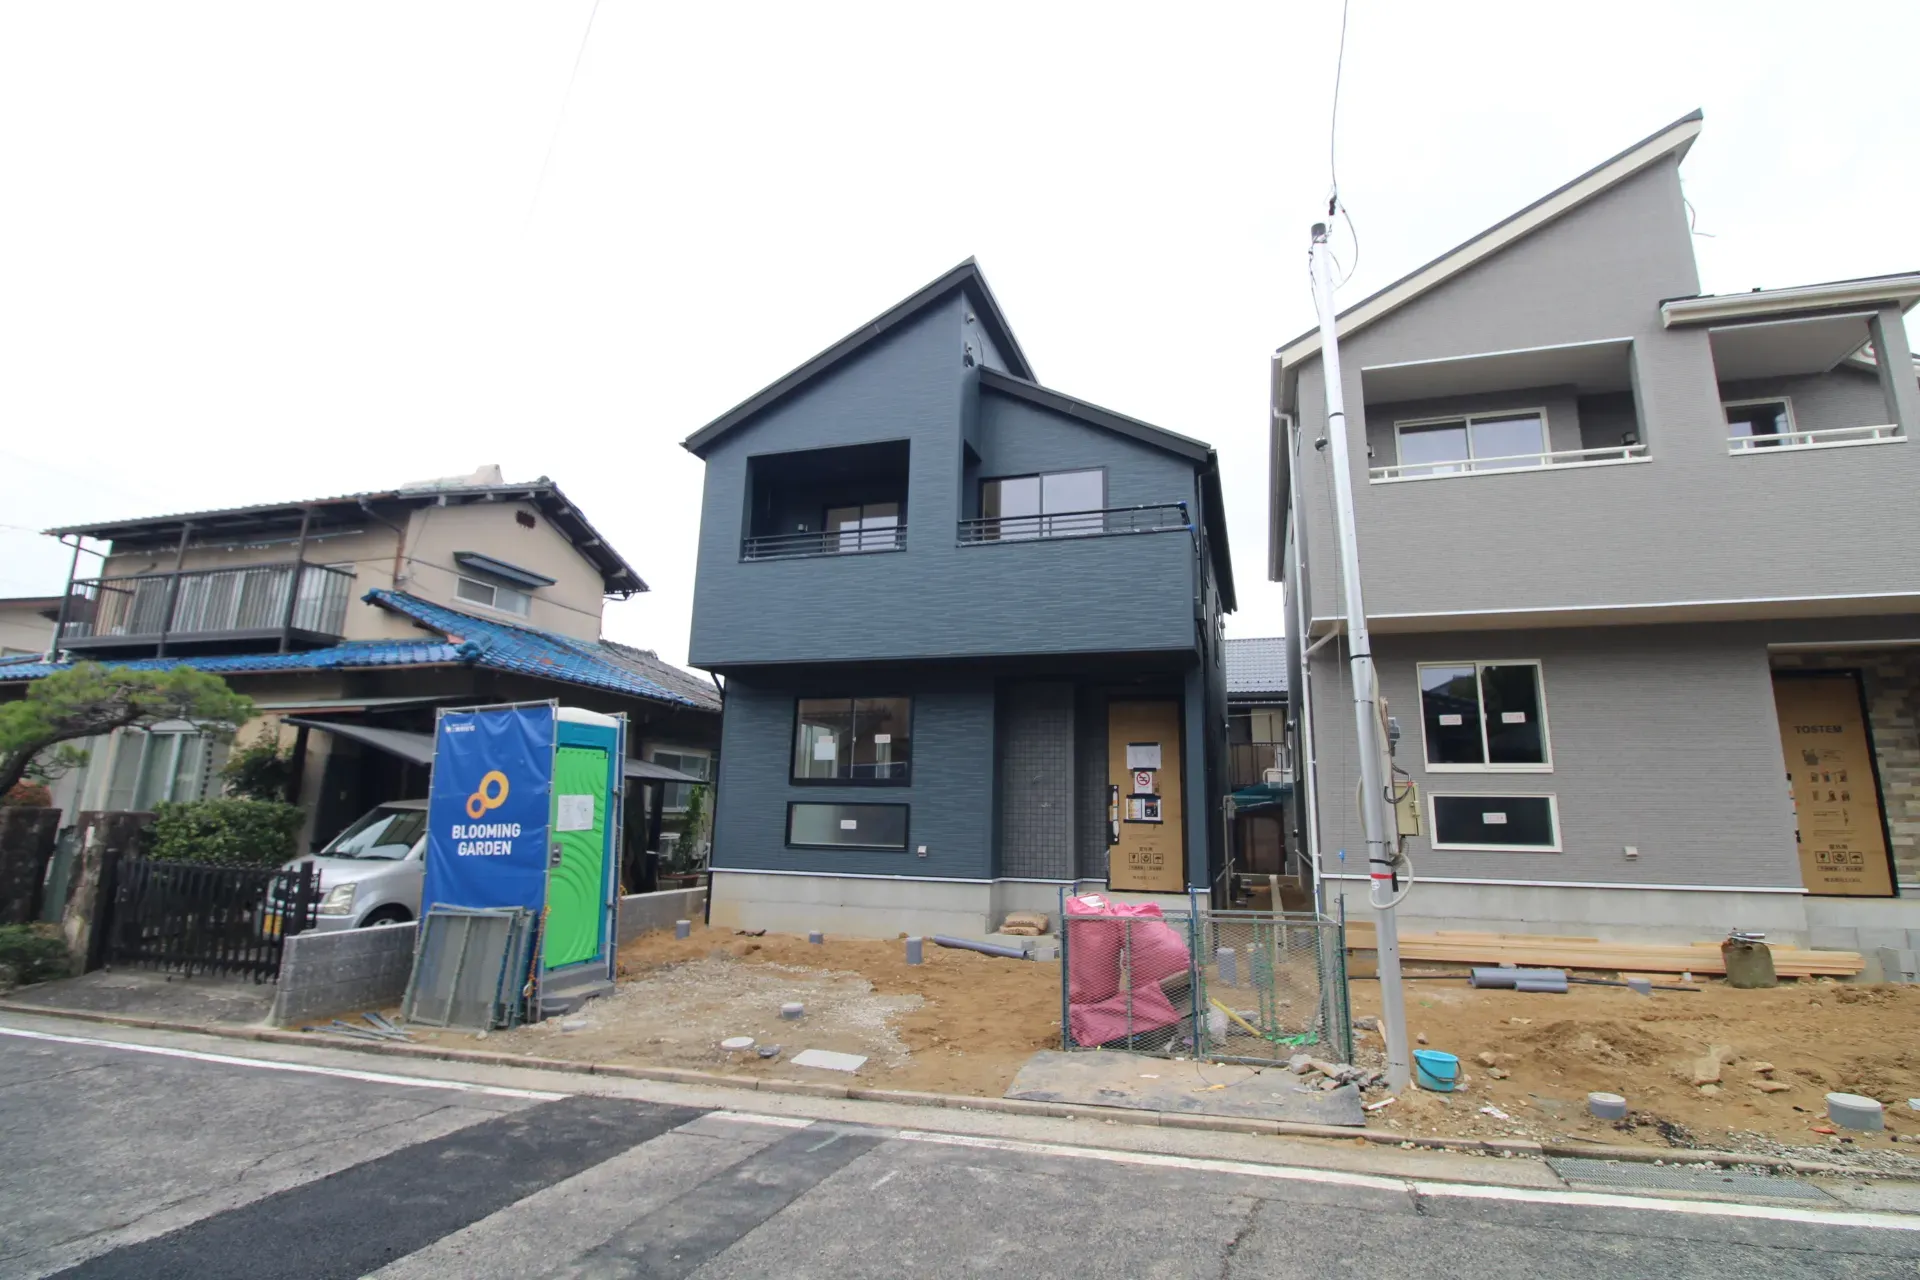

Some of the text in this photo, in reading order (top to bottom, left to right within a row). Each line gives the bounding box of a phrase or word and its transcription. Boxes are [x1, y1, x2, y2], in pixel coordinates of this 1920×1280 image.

[1793, 725, 1843, 734] TOSTEM
[452, 823, 521, 839] BLOOMING
[457, 841, 512, 856] GARDEN
